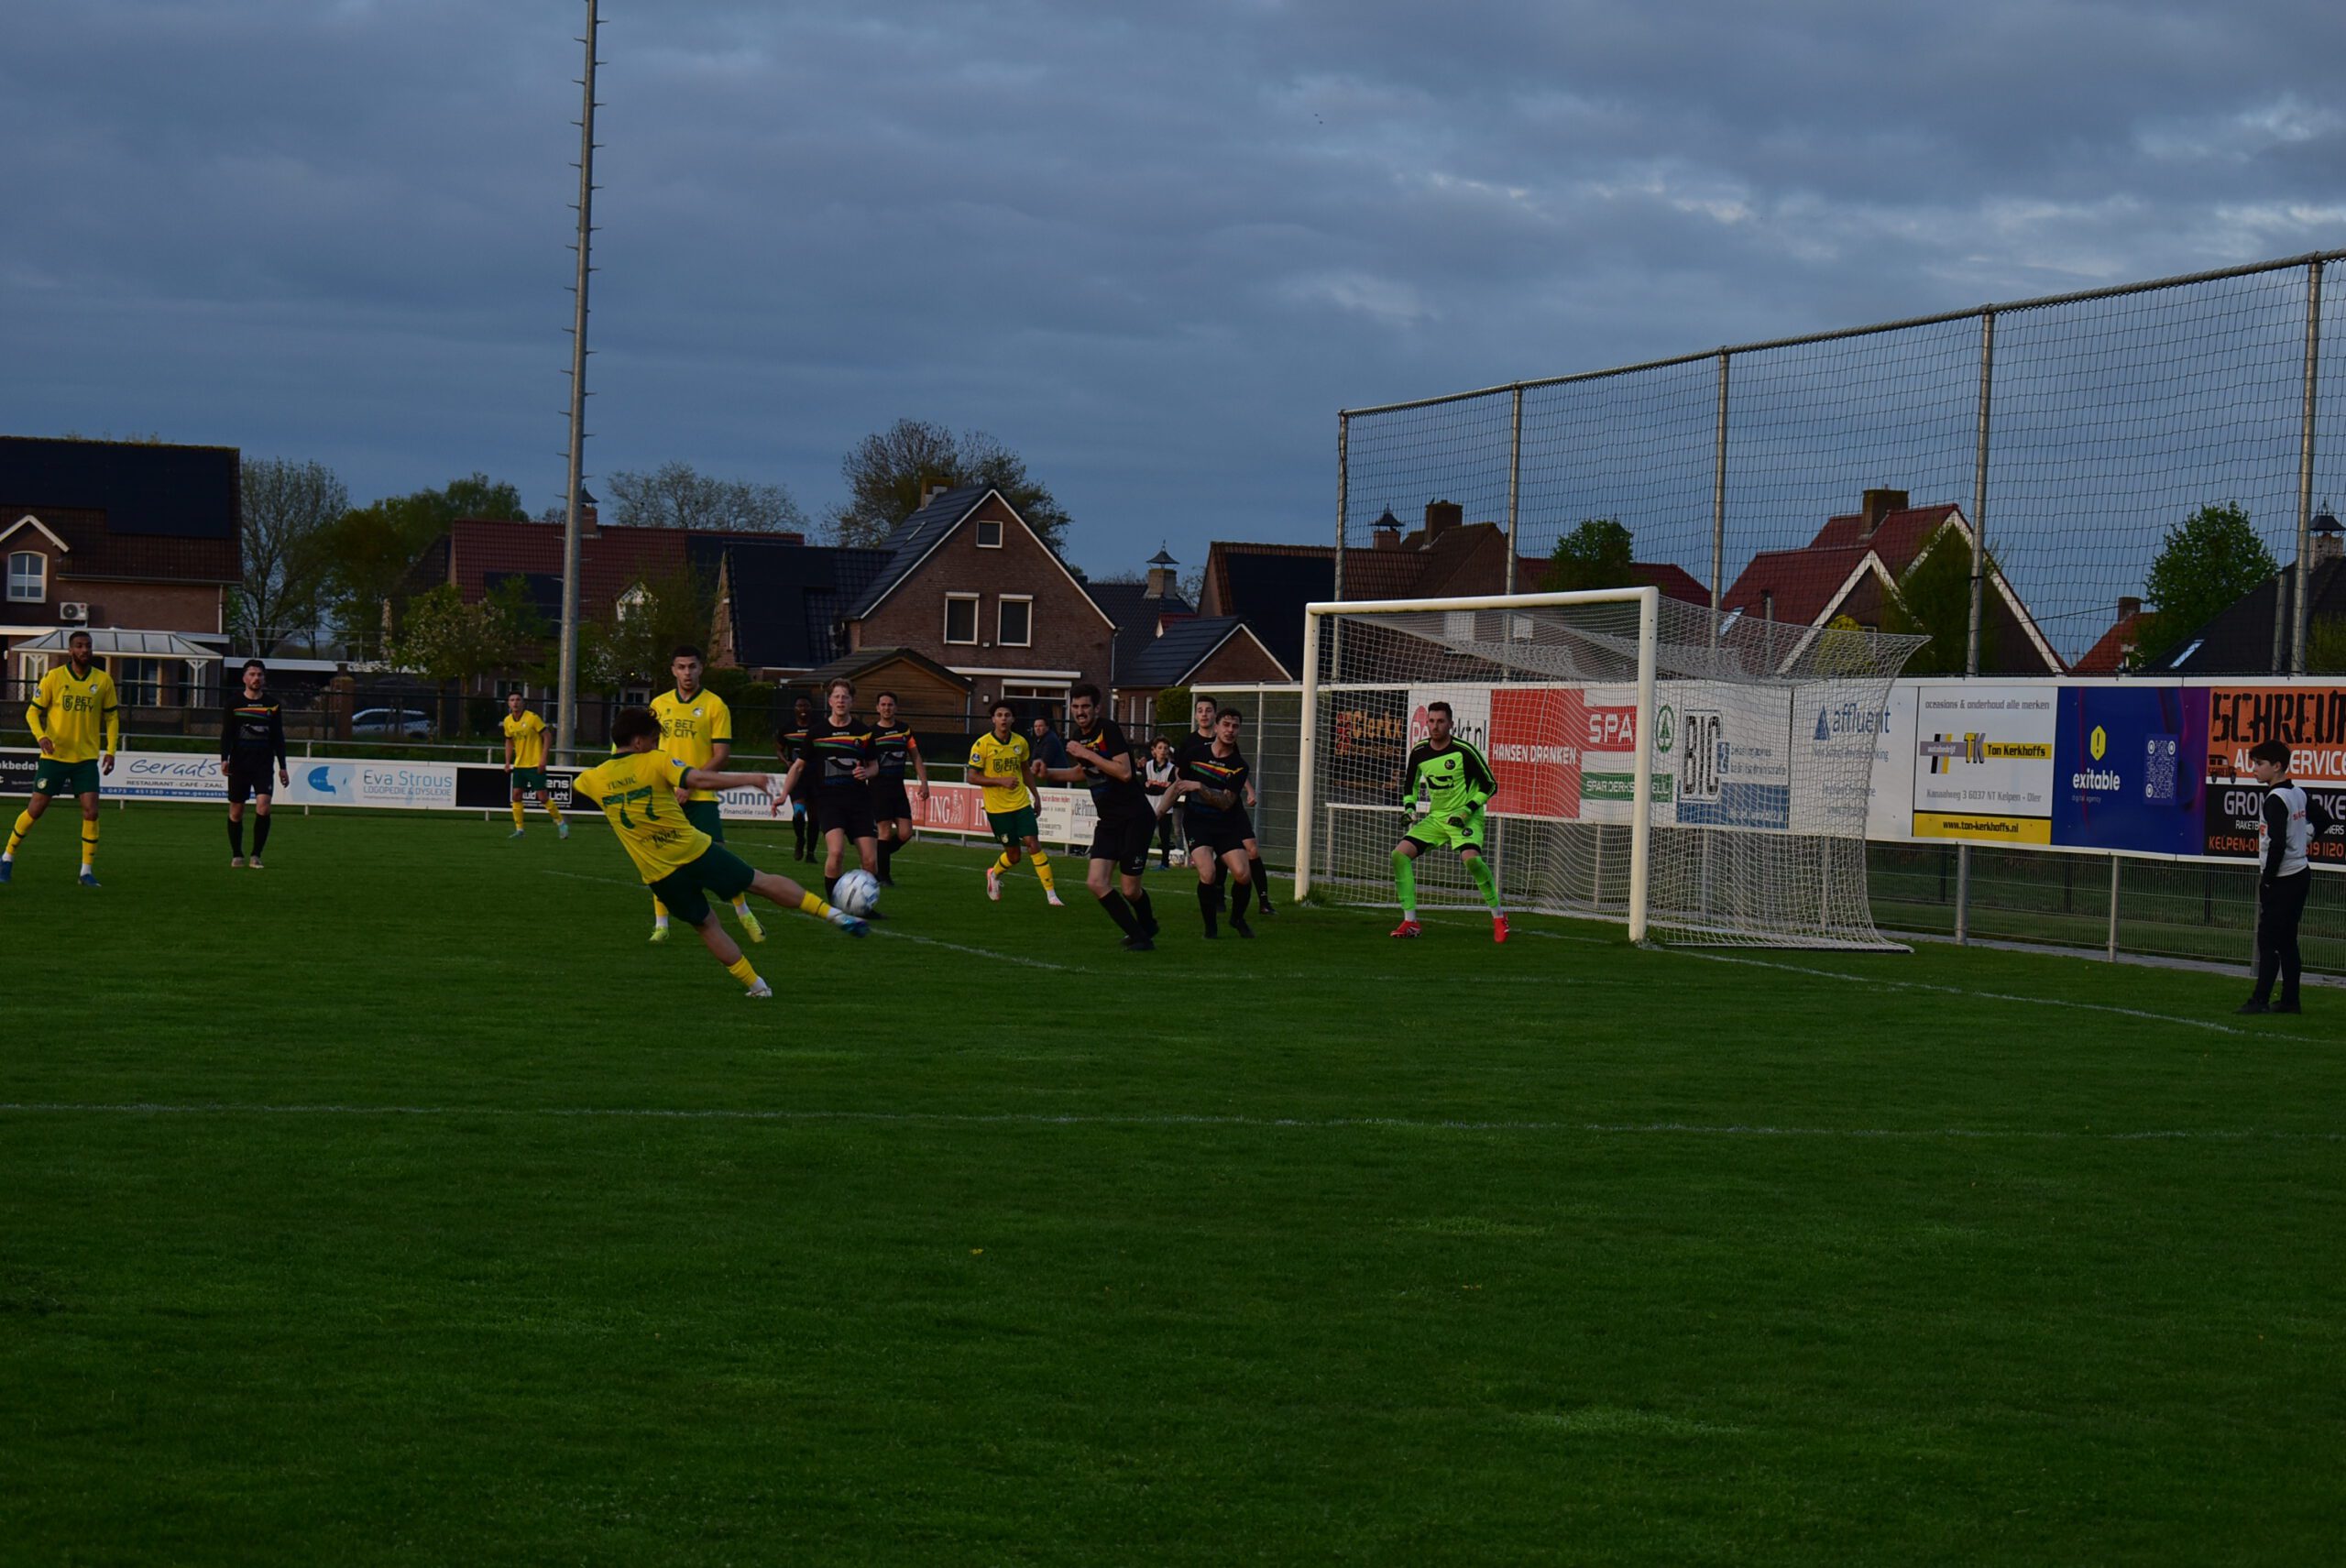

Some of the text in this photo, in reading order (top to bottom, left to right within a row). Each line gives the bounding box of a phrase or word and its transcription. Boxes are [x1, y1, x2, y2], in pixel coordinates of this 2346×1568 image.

[75, 696, 92, 704] BET
[1925, 699, 2050, 710] occasions & onderhoud alle merken
[75, 704, 93, 712] CITY
[674, 719, 695, 729] BET
[1833, 704, 1891, 733] affluent
[674, 729, 697, 740] CITY
[1588, 713, 1633, 744] SPA
[1492, 743, 1577, 765] HANSEN DRANKEN
[1987, 745, 2046, 757] Ton Kerkhoffs
[129, 759, 222, 778] Geraats
[364, 770, 453, 787] Eva Strous
[2072, 767, 2121, 791] exitable
[363, 786, 406, 795] LOGOPEDIE
[416, 788, 452, 796] DYSLEXIE
[1968, 790, 1986, 800] 6037
[1997, 792, 2022, 804] Kelpen
[602, 784, 661, 829] 77
[929, 795, 950, 824] ING
[1943, 821, 2019, 833] www.ton-kerkhoffs.nl
[2235, 819, 2260, 831] RAKETB
